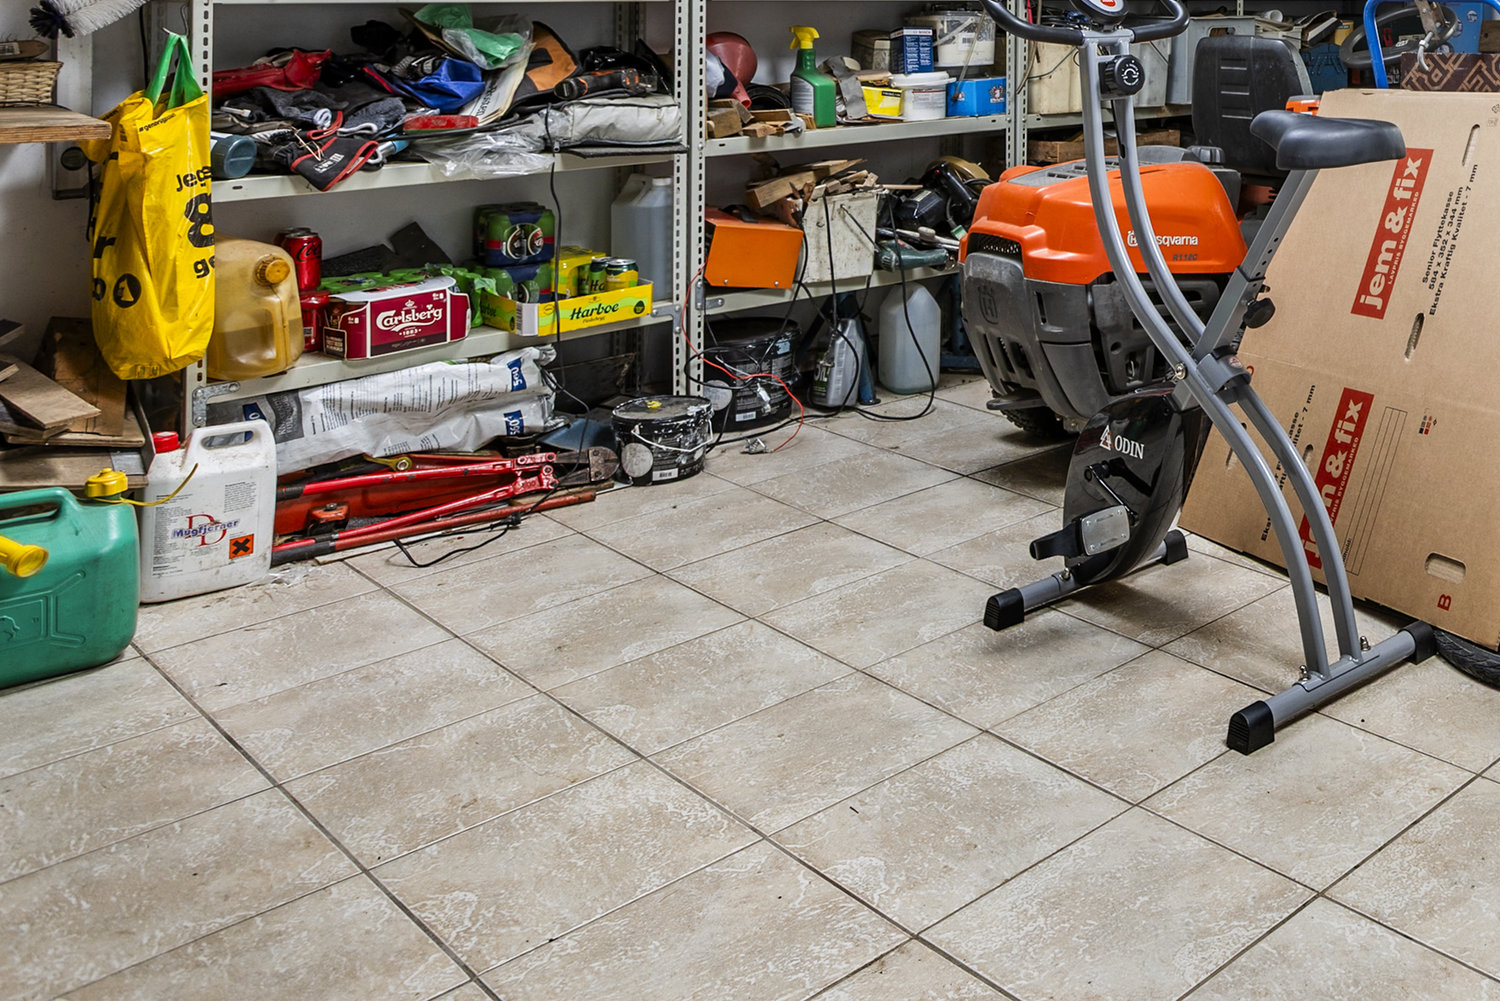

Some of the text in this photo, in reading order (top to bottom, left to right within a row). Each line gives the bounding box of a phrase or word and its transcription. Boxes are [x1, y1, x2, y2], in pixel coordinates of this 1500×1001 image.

[1359, 157, 1423, 310] jem & fix
[1399, 191, 1420, 251] BYGGEMARKED
[1421, 190, 1455, 284] Senior Flyttekasse
[1428, 270, 1439, 290] 584
[1438, 239, 1449, 257] 352
[1447, 207, 1457, 227] 344
[1455, 186, 1464, 205] mm
[1429, 281, 1445, 316] Ekstra
[1440, 243, 1456, 280] Kraftig
[1452, 201, 1468, 242] Kvalitet
[1469, 164, 1478, 183] mm
[1156, 235, 1199, 247] sqvarna
[375, 305, 443, 332] Carlsberg
[569, 301, 620, 321] Harboe
[1306, 384, 1316, 405] mm
[1333, 398, 1364, 444] fix
[1114, 434, 1145, 460] ODIN
[1324, 449, 1349, 479] &
[1337, 436, 1360, 497] BYGGEMARKED
[1436, 593, 1452, 612] B
